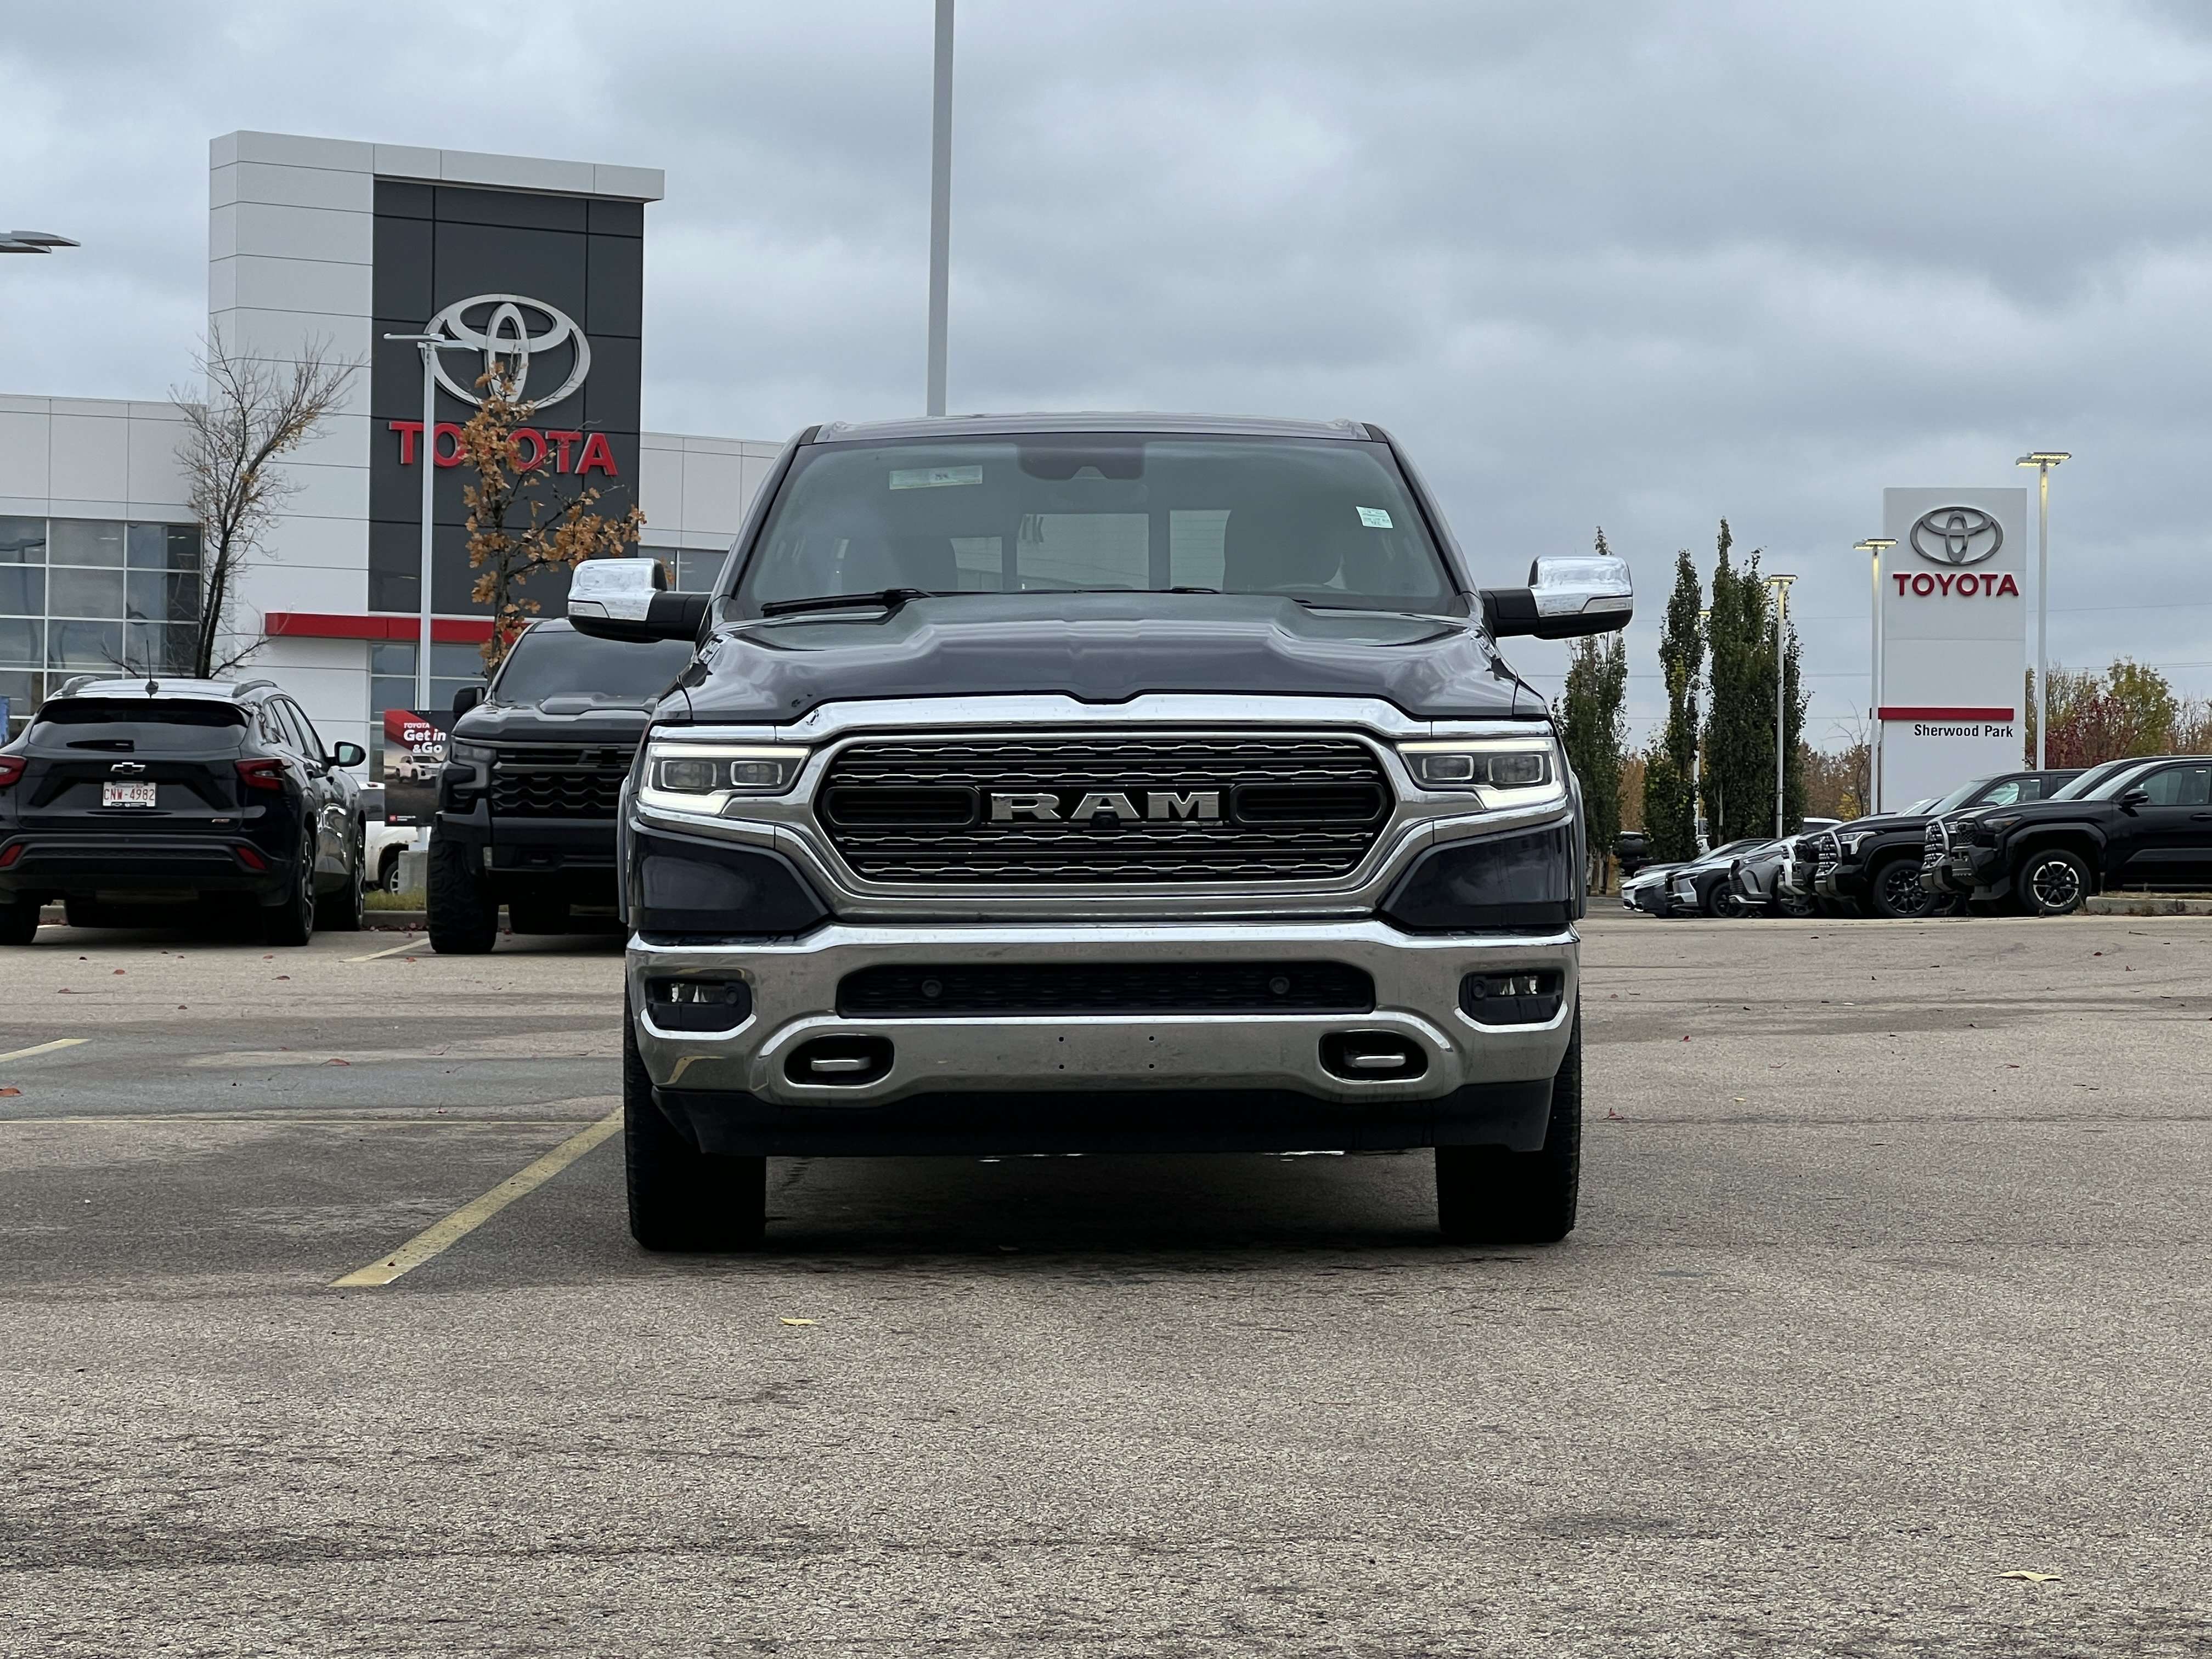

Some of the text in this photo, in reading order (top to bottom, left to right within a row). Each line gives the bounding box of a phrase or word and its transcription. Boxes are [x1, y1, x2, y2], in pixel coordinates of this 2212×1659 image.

[388, 421, 618, 476] TOOTA
[1893, 573, 2019, 596] TOYOTA
[403, 729, 446, 741] Get in
[1914, 724, 2013, 737] Sherwood Park
[991, 792, 1219, 820] RAM
